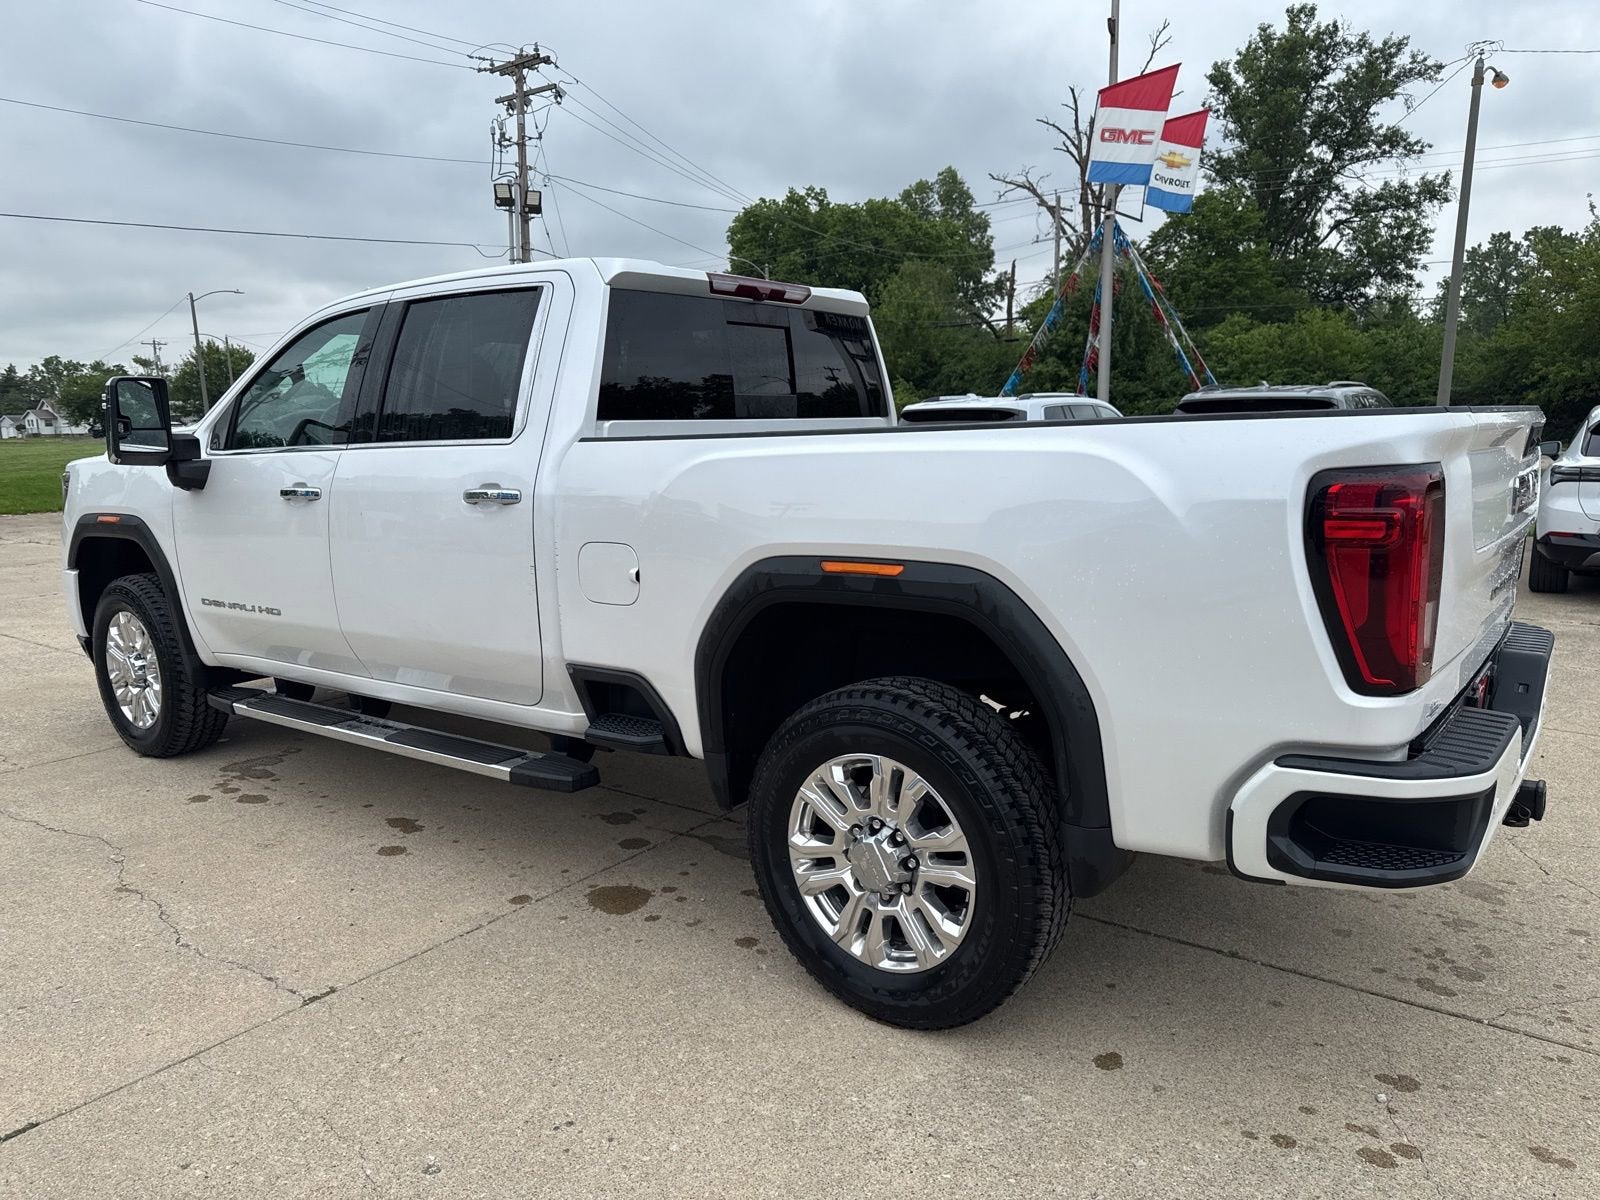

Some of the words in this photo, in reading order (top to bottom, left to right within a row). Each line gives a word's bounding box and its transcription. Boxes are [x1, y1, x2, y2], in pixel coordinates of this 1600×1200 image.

[1100, 127, 1155, 145] GMC
[201, 598, 256, 612] DENALI
[258, 606, 282, 616] HD
